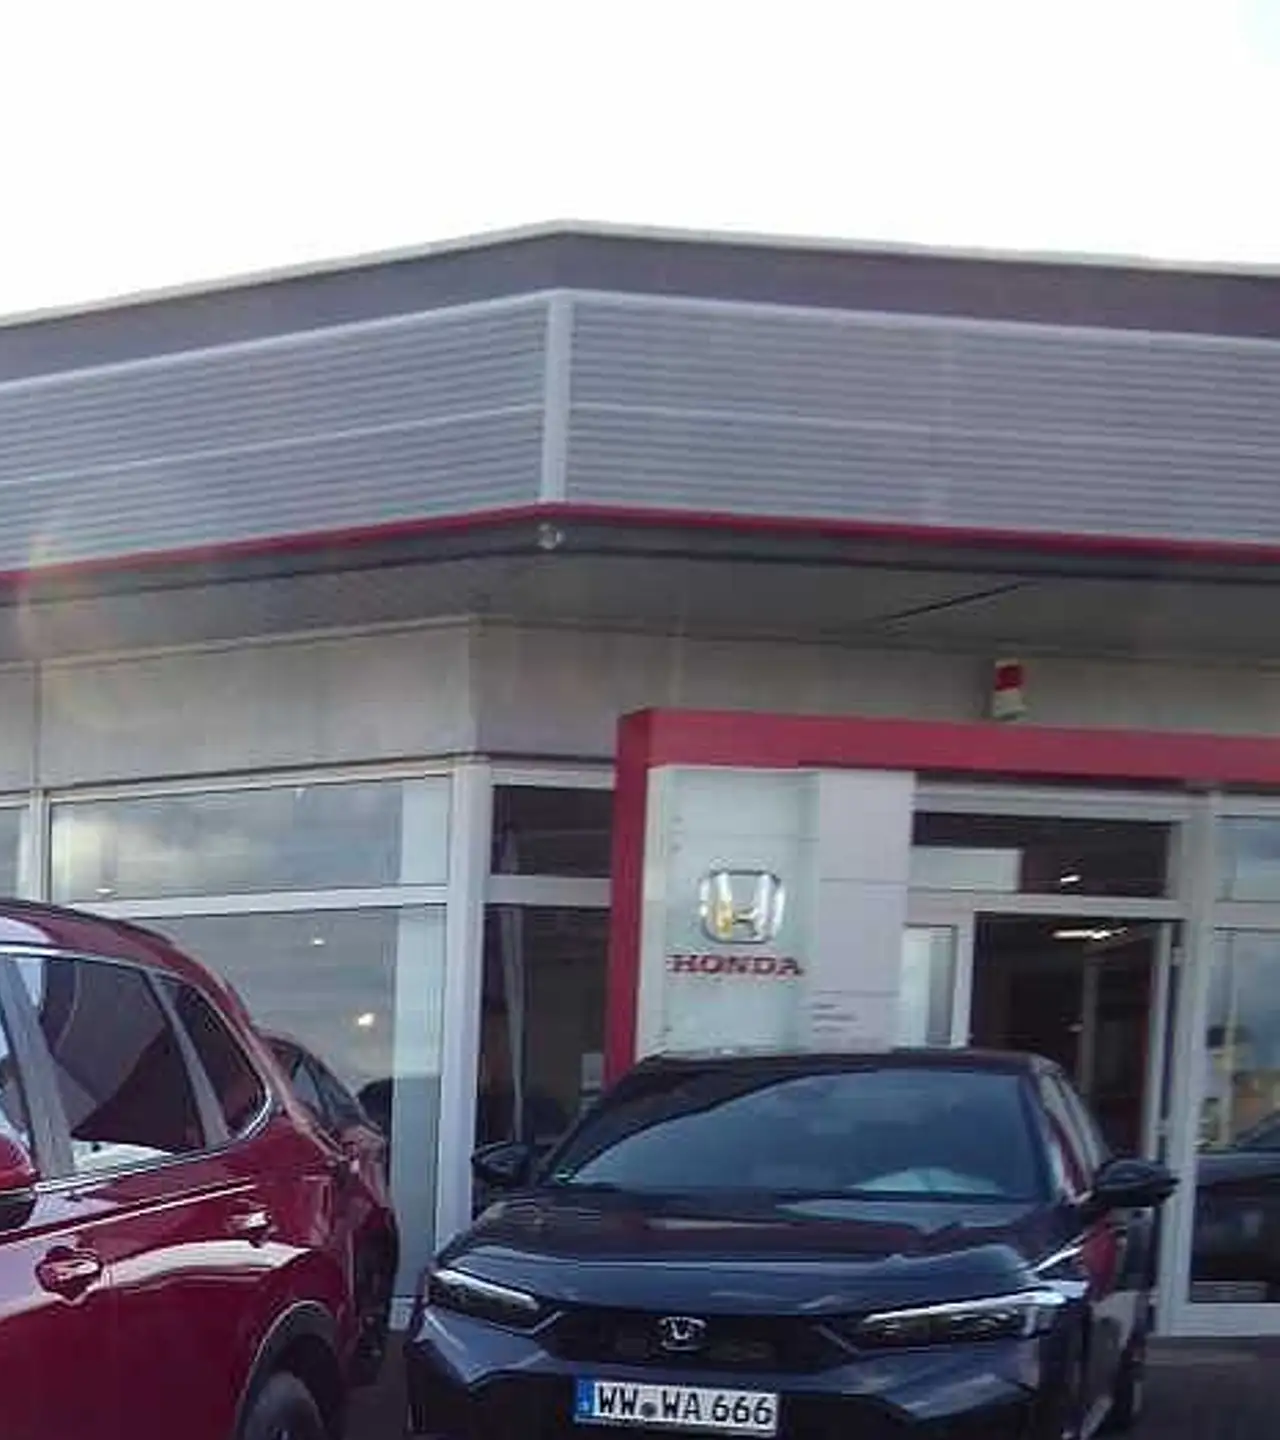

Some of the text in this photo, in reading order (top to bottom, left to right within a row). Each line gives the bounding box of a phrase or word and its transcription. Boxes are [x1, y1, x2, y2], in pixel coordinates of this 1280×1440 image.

[665, 954, 805, 976] HONDA
[662, 1390, 701, 1421] WA
[712, 1395, 772, 1425] 666
